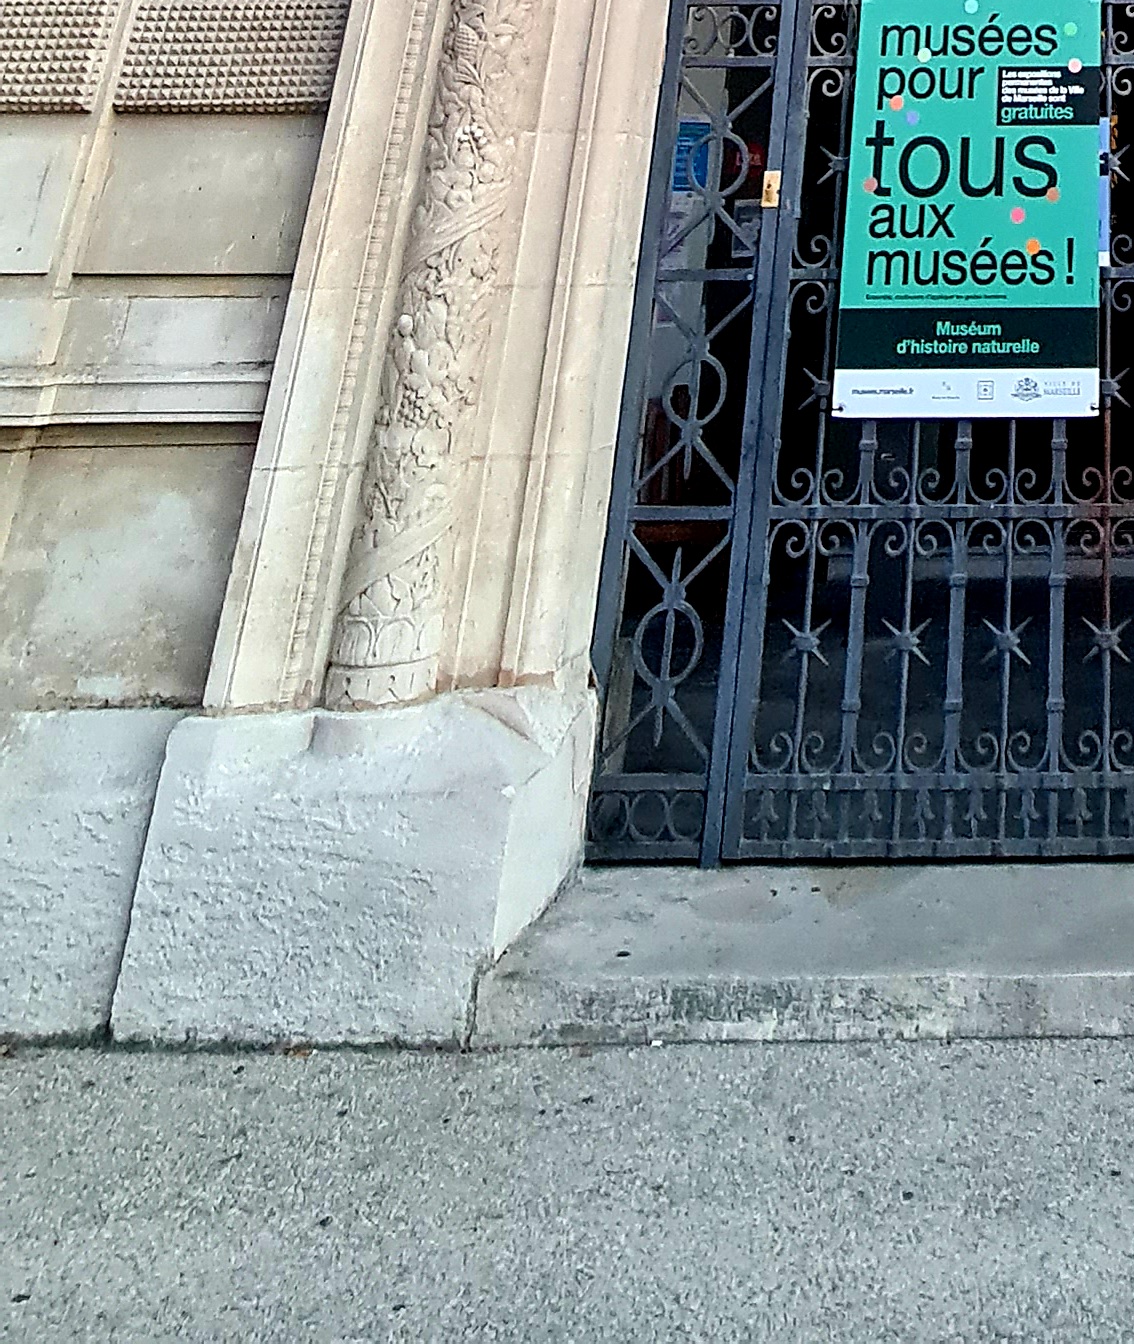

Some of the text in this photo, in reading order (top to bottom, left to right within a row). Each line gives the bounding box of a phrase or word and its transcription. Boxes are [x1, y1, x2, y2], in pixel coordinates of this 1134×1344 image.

[880, 13, 1058, 57] musées
[877, 66, 984, 111] pour
[1001, 103, 1074, 123] gratuites
[865, 119, 1059, 199] tous
[868, 203, 956, 239] aux
[866, 237, 1056, 286] musées
[896, 338, 1040, 354] d'histoire naturelle
[936, 320, 1002, 336] Muséum
